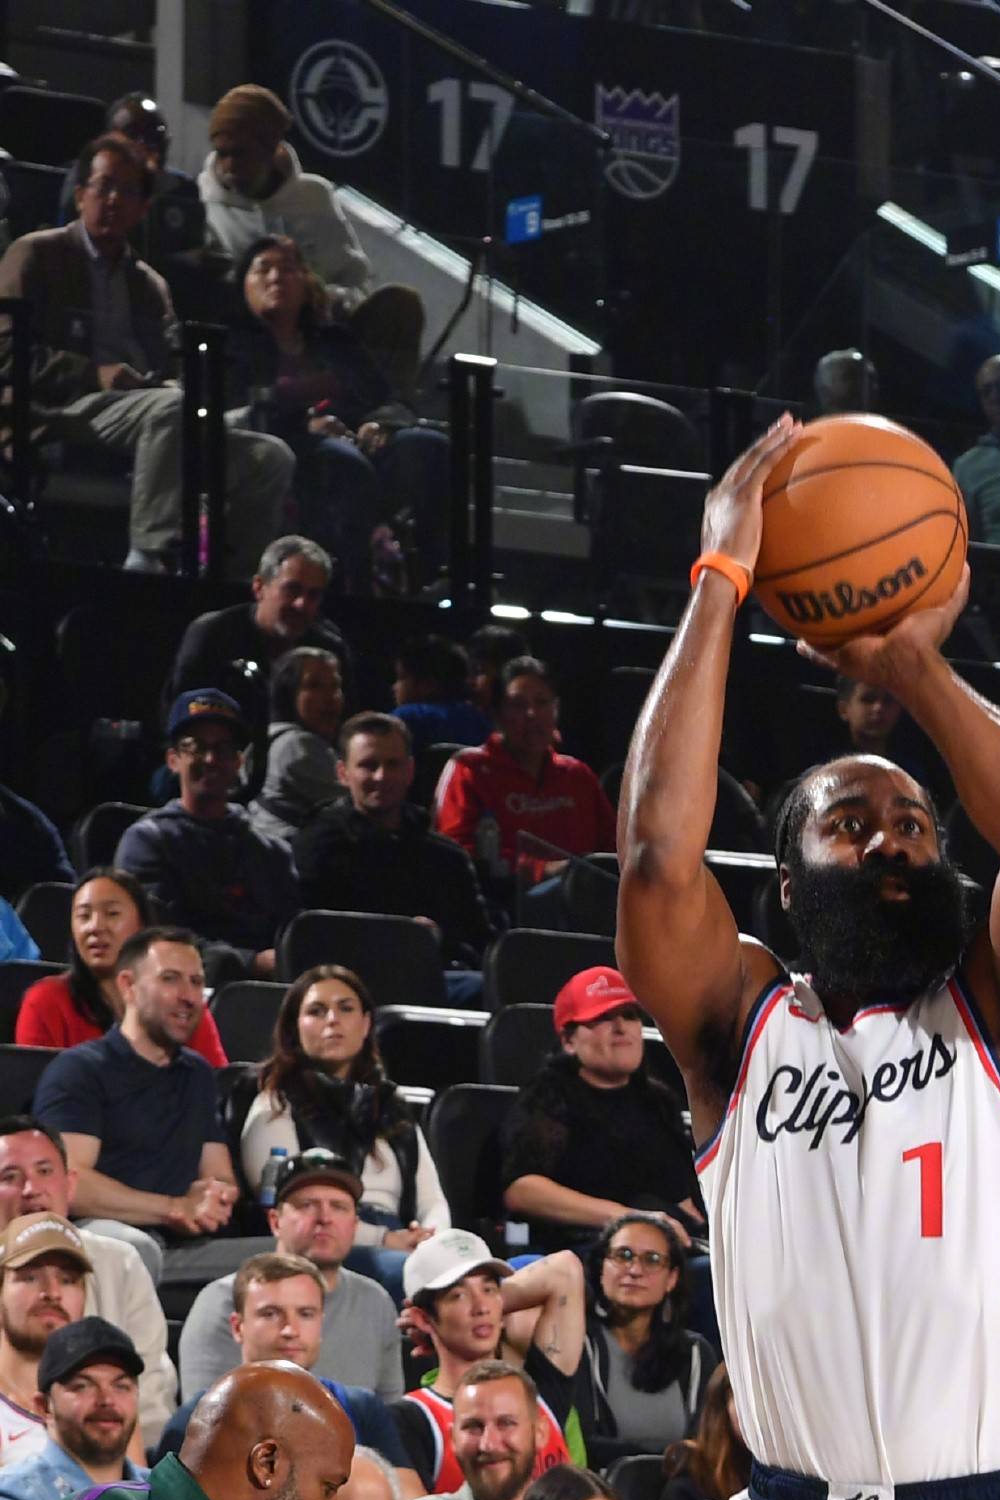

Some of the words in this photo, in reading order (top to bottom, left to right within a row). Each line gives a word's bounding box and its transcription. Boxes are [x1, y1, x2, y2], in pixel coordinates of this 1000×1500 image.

[427, 78, 515, 172] 17
[733, 122, 818, 215] 17
[776, 556, 928, 625] Wilson
[756, 1033, 958, 1152] Clippers
[902, 1142, 943, 1238] 1
